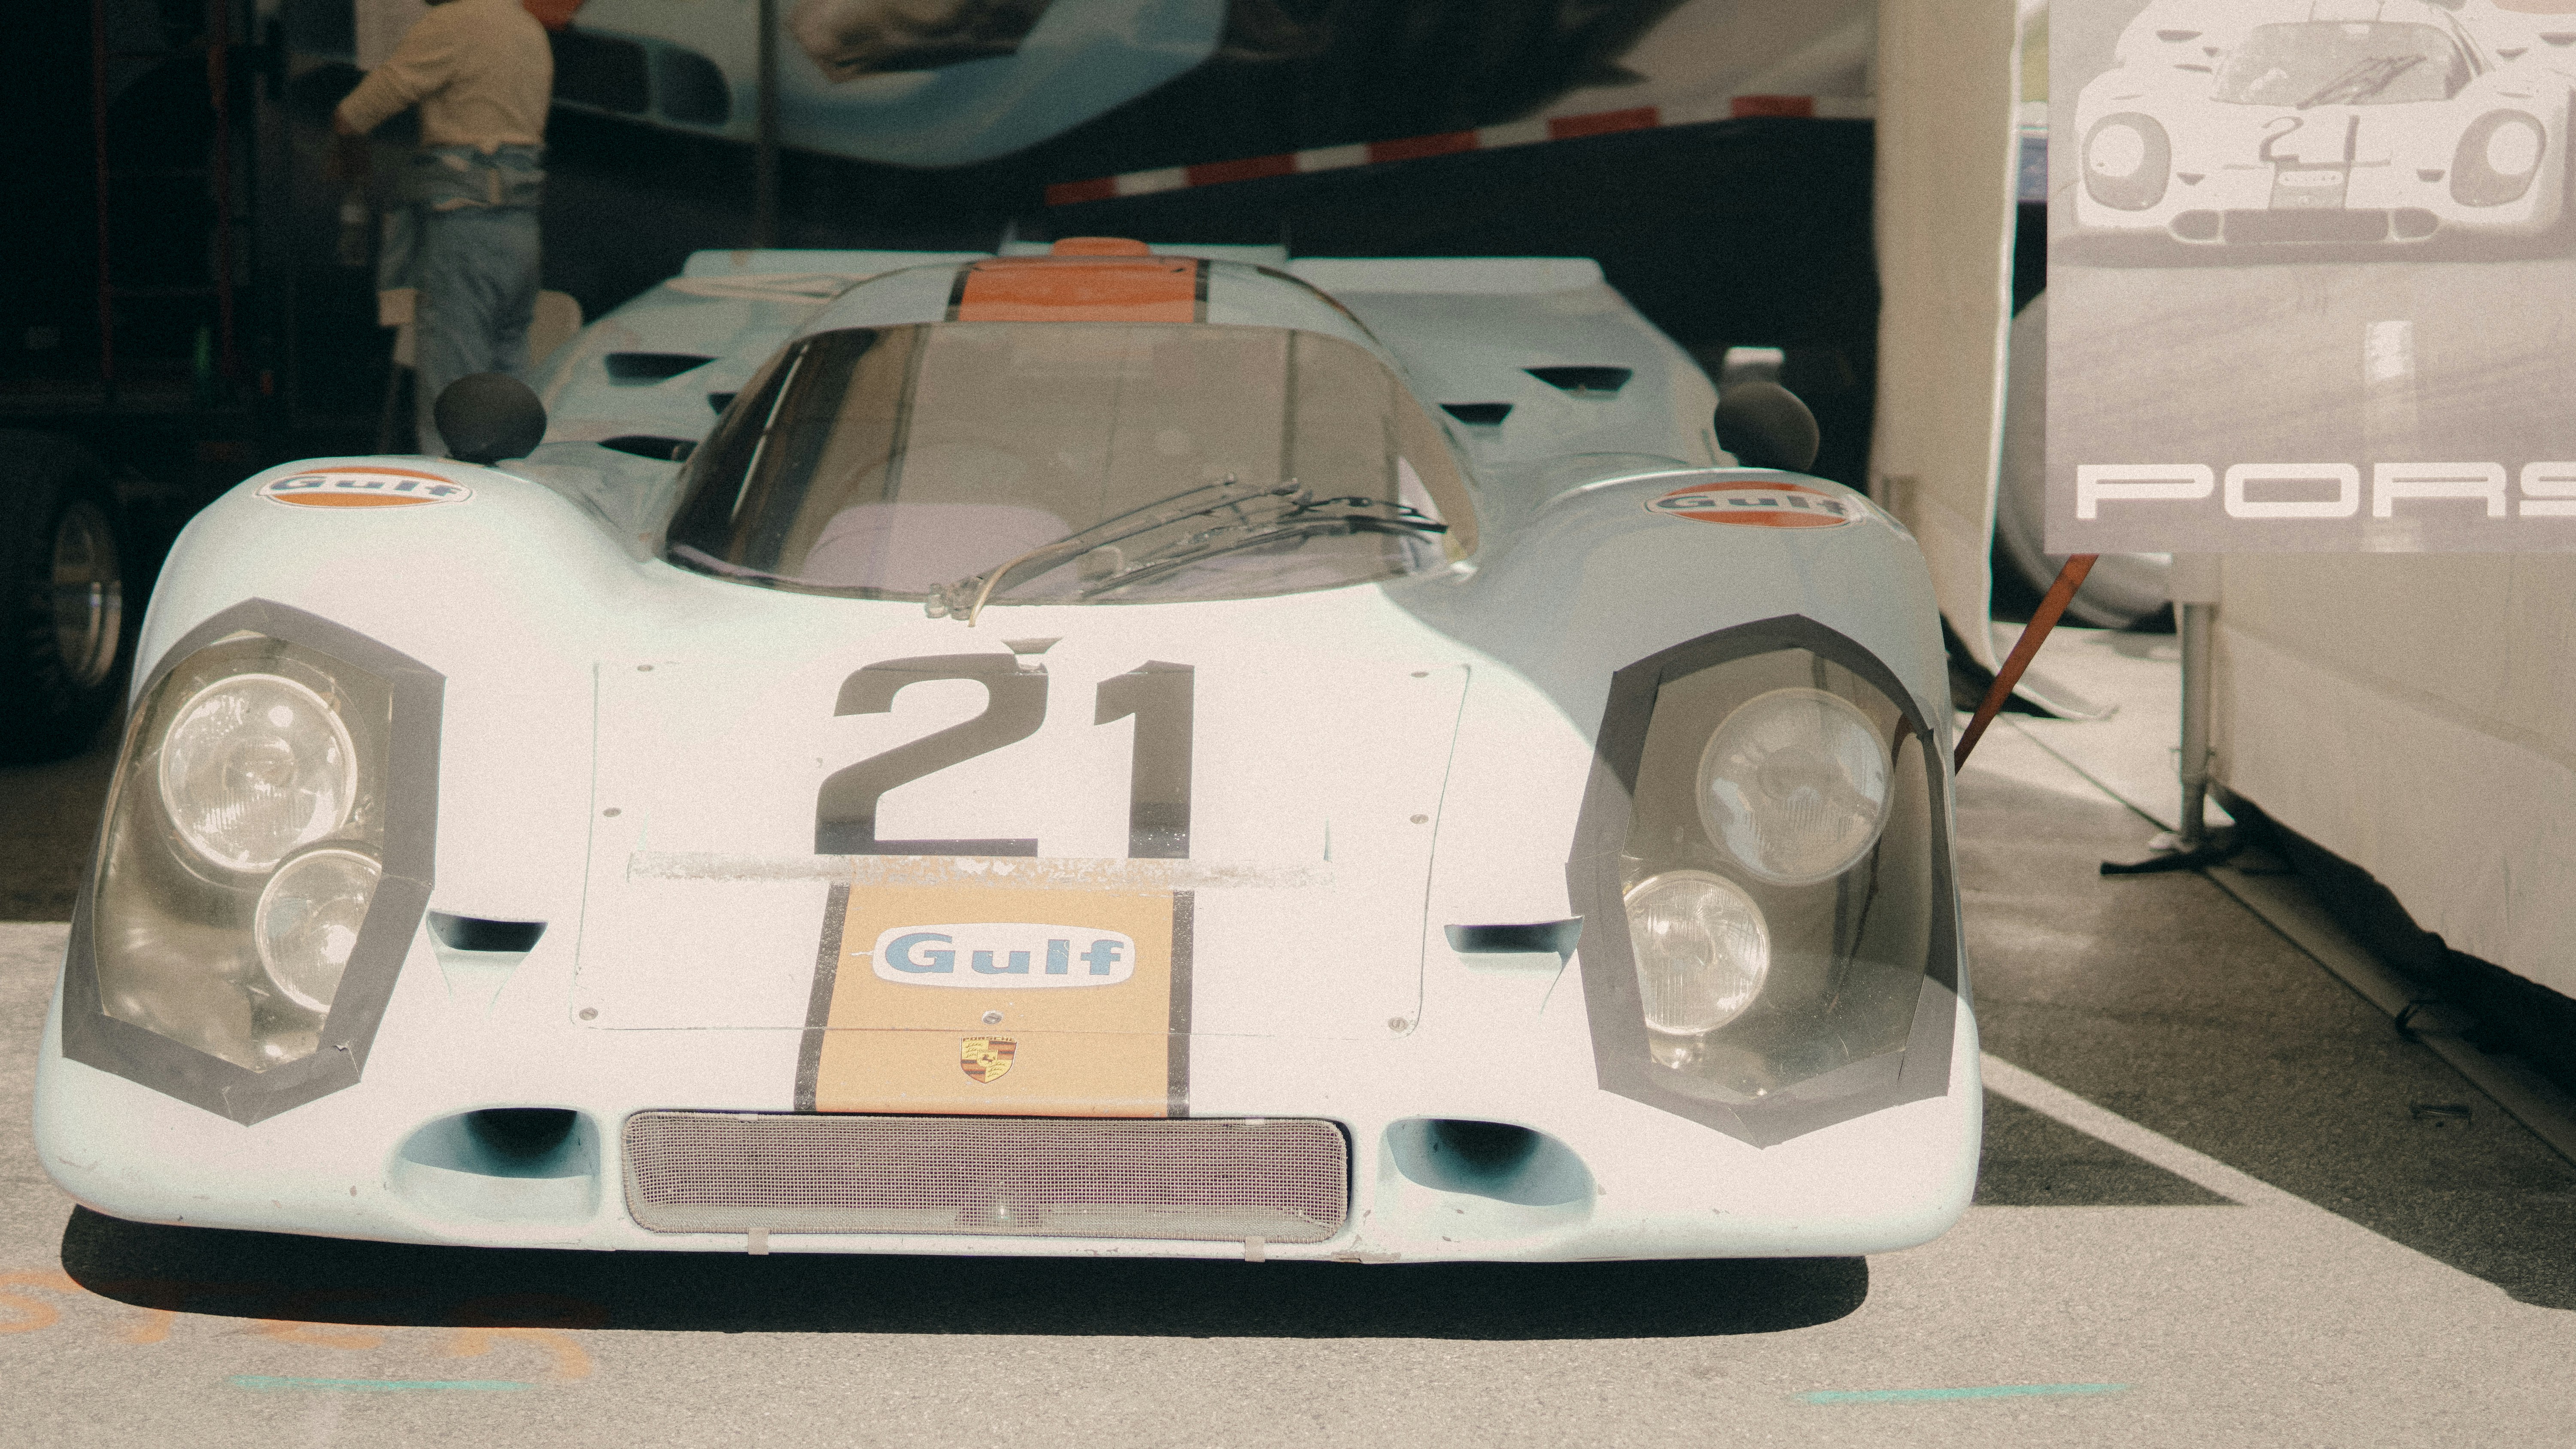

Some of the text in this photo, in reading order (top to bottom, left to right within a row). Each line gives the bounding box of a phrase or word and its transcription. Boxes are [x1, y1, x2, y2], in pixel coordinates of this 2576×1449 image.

[2259, 115, 2360, 161] 21
[270, 476, 463, 497] Gulf
[1656, 495, 1846, 515] Gulf
[814, 652, 1195, 859] 21
[885, 932, 1124, 975] Gulf
